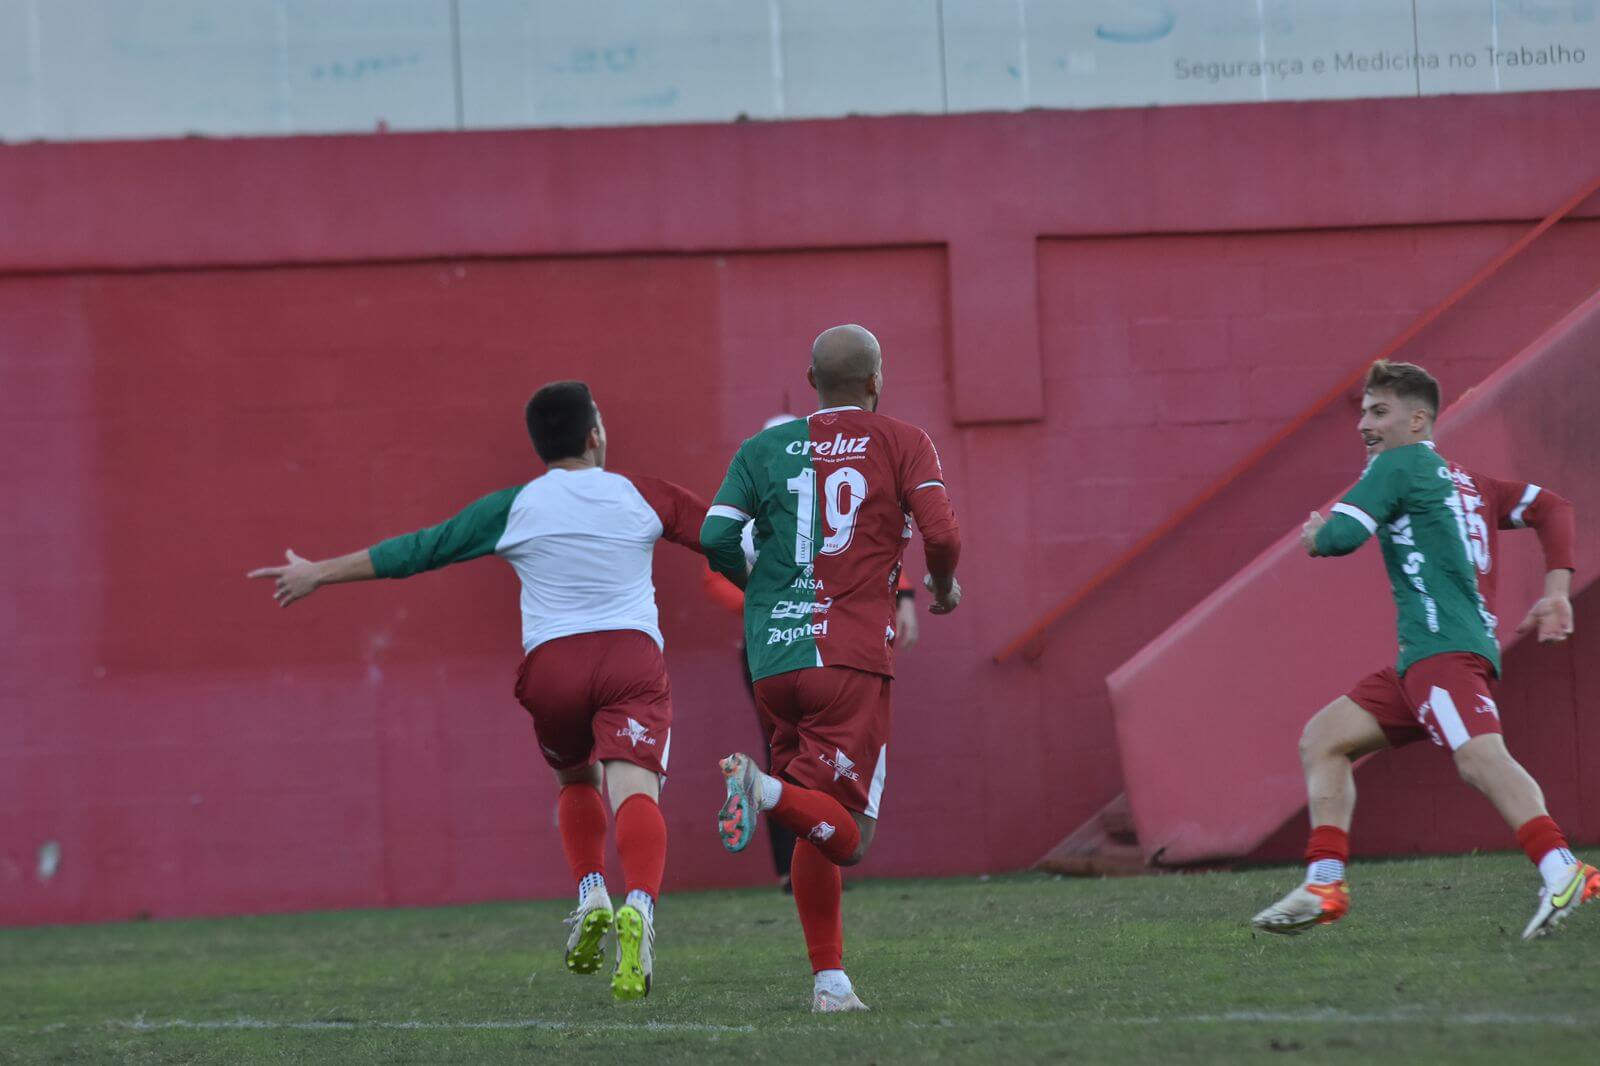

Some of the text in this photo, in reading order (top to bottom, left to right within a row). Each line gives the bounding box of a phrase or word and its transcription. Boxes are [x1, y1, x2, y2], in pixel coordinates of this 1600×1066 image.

[1174, 43, 1586, 84] Segurança e Medicina no Trabalho
[785, 432, 870, 456] creluz
[786, 466, 869, 567] 19
[1444, 490, 1493, 575] 15
